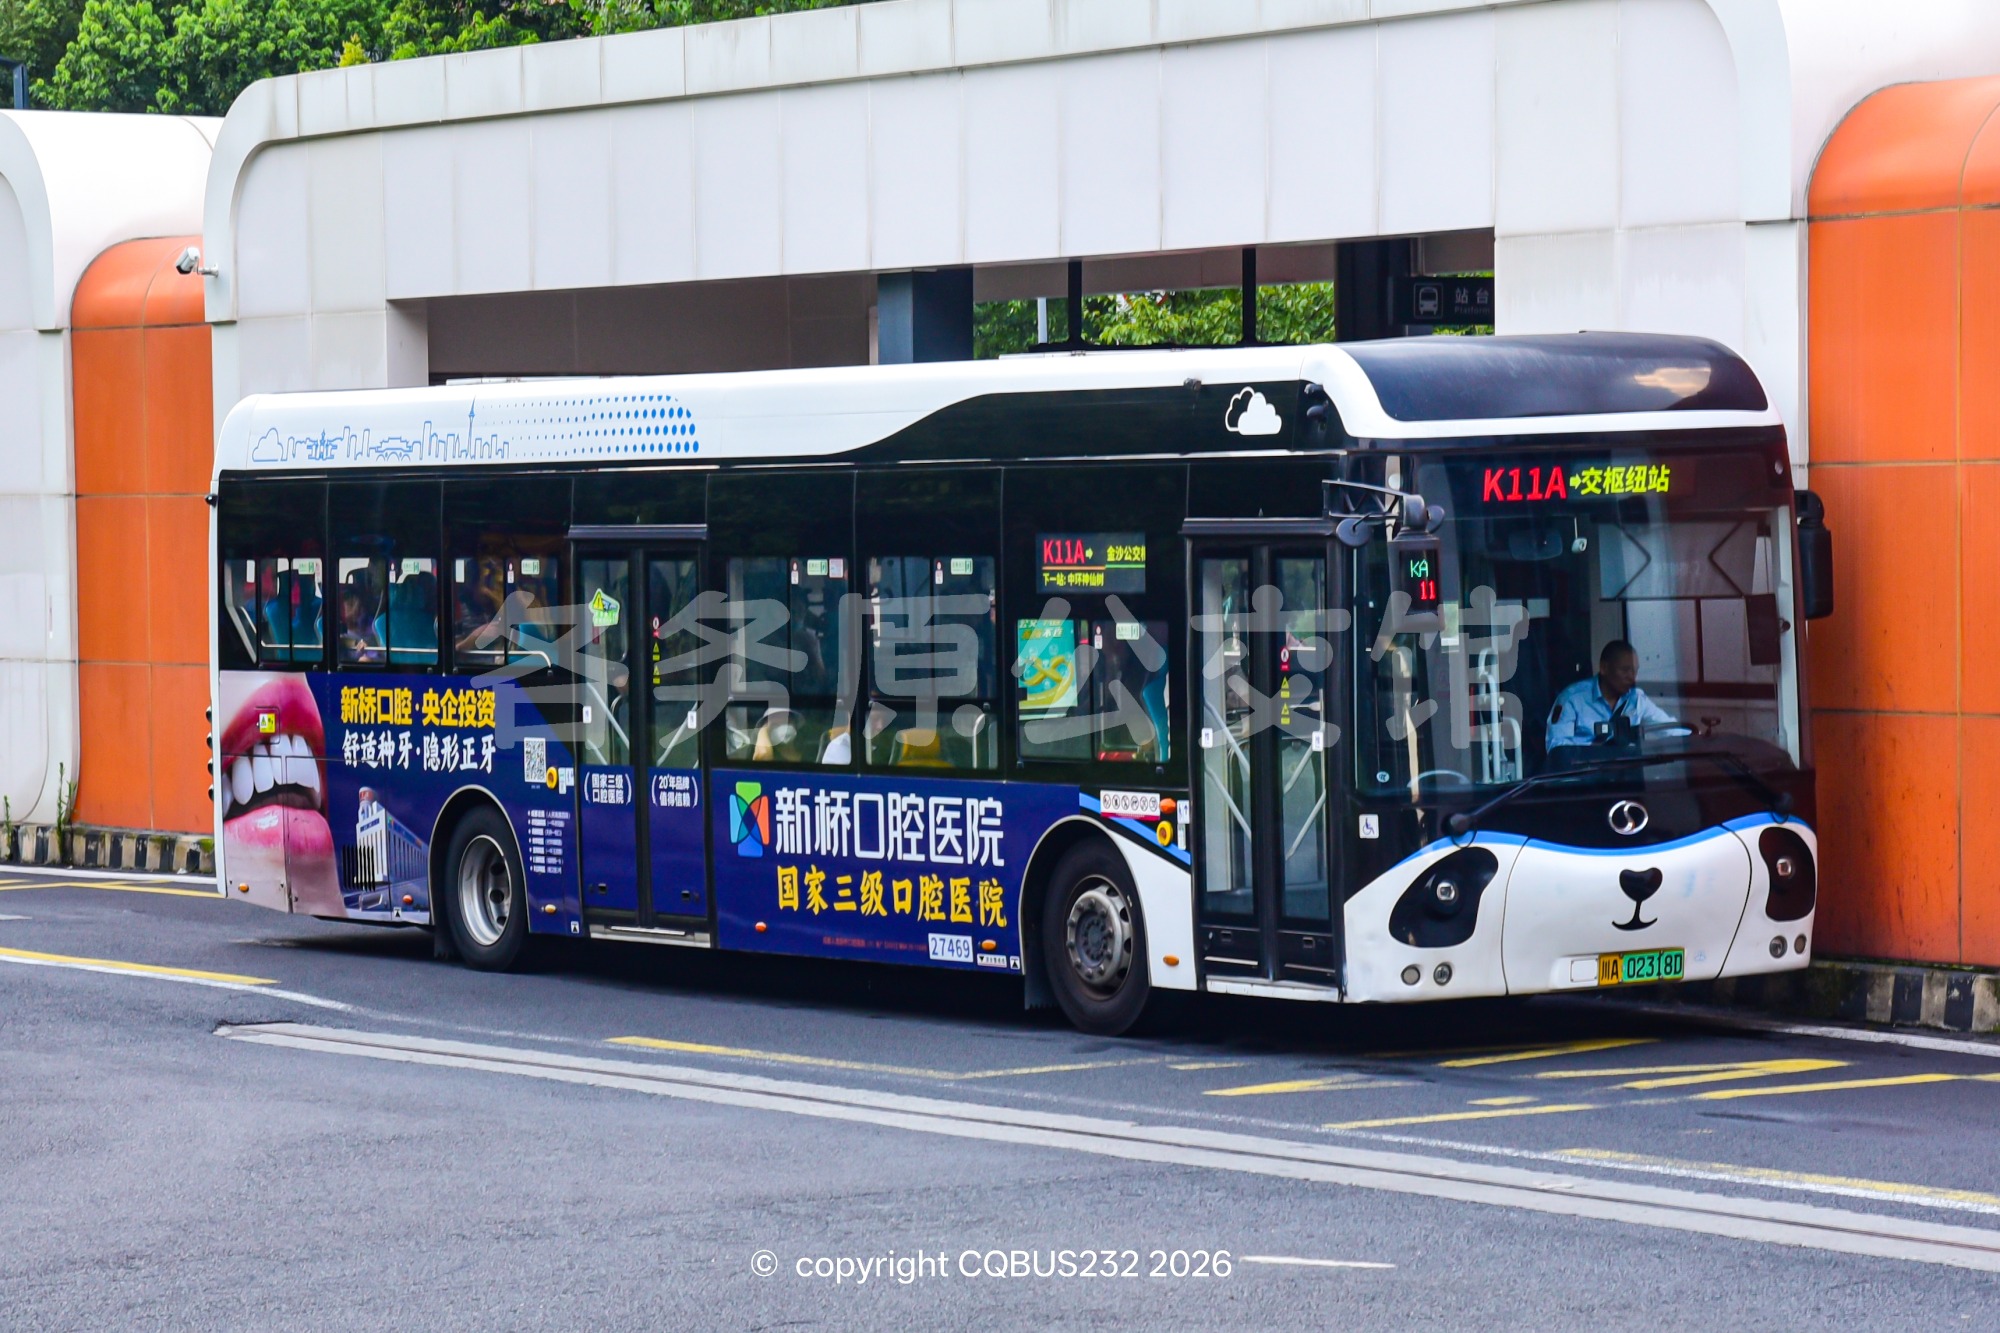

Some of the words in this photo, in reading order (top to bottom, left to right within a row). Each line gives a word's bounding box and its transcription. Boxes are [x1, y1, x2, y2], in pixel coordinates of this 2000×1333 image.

[1455, 287, 1489, 304] 站台
[1482, 466, 1567, 501] K11A
[1580, 464, 1670, 495] 交枢纽站
[1043, 539, 1086, 564] K11A
[1410, 559, 1429, 578] KA
[1420, 580, 1437, 600] 11
[775, 786, 1005, 867] 新桥口腔医院
[777, 864, 1007, 928] 国家三级口腔医院
[931, 937, 970, 958] 27469
